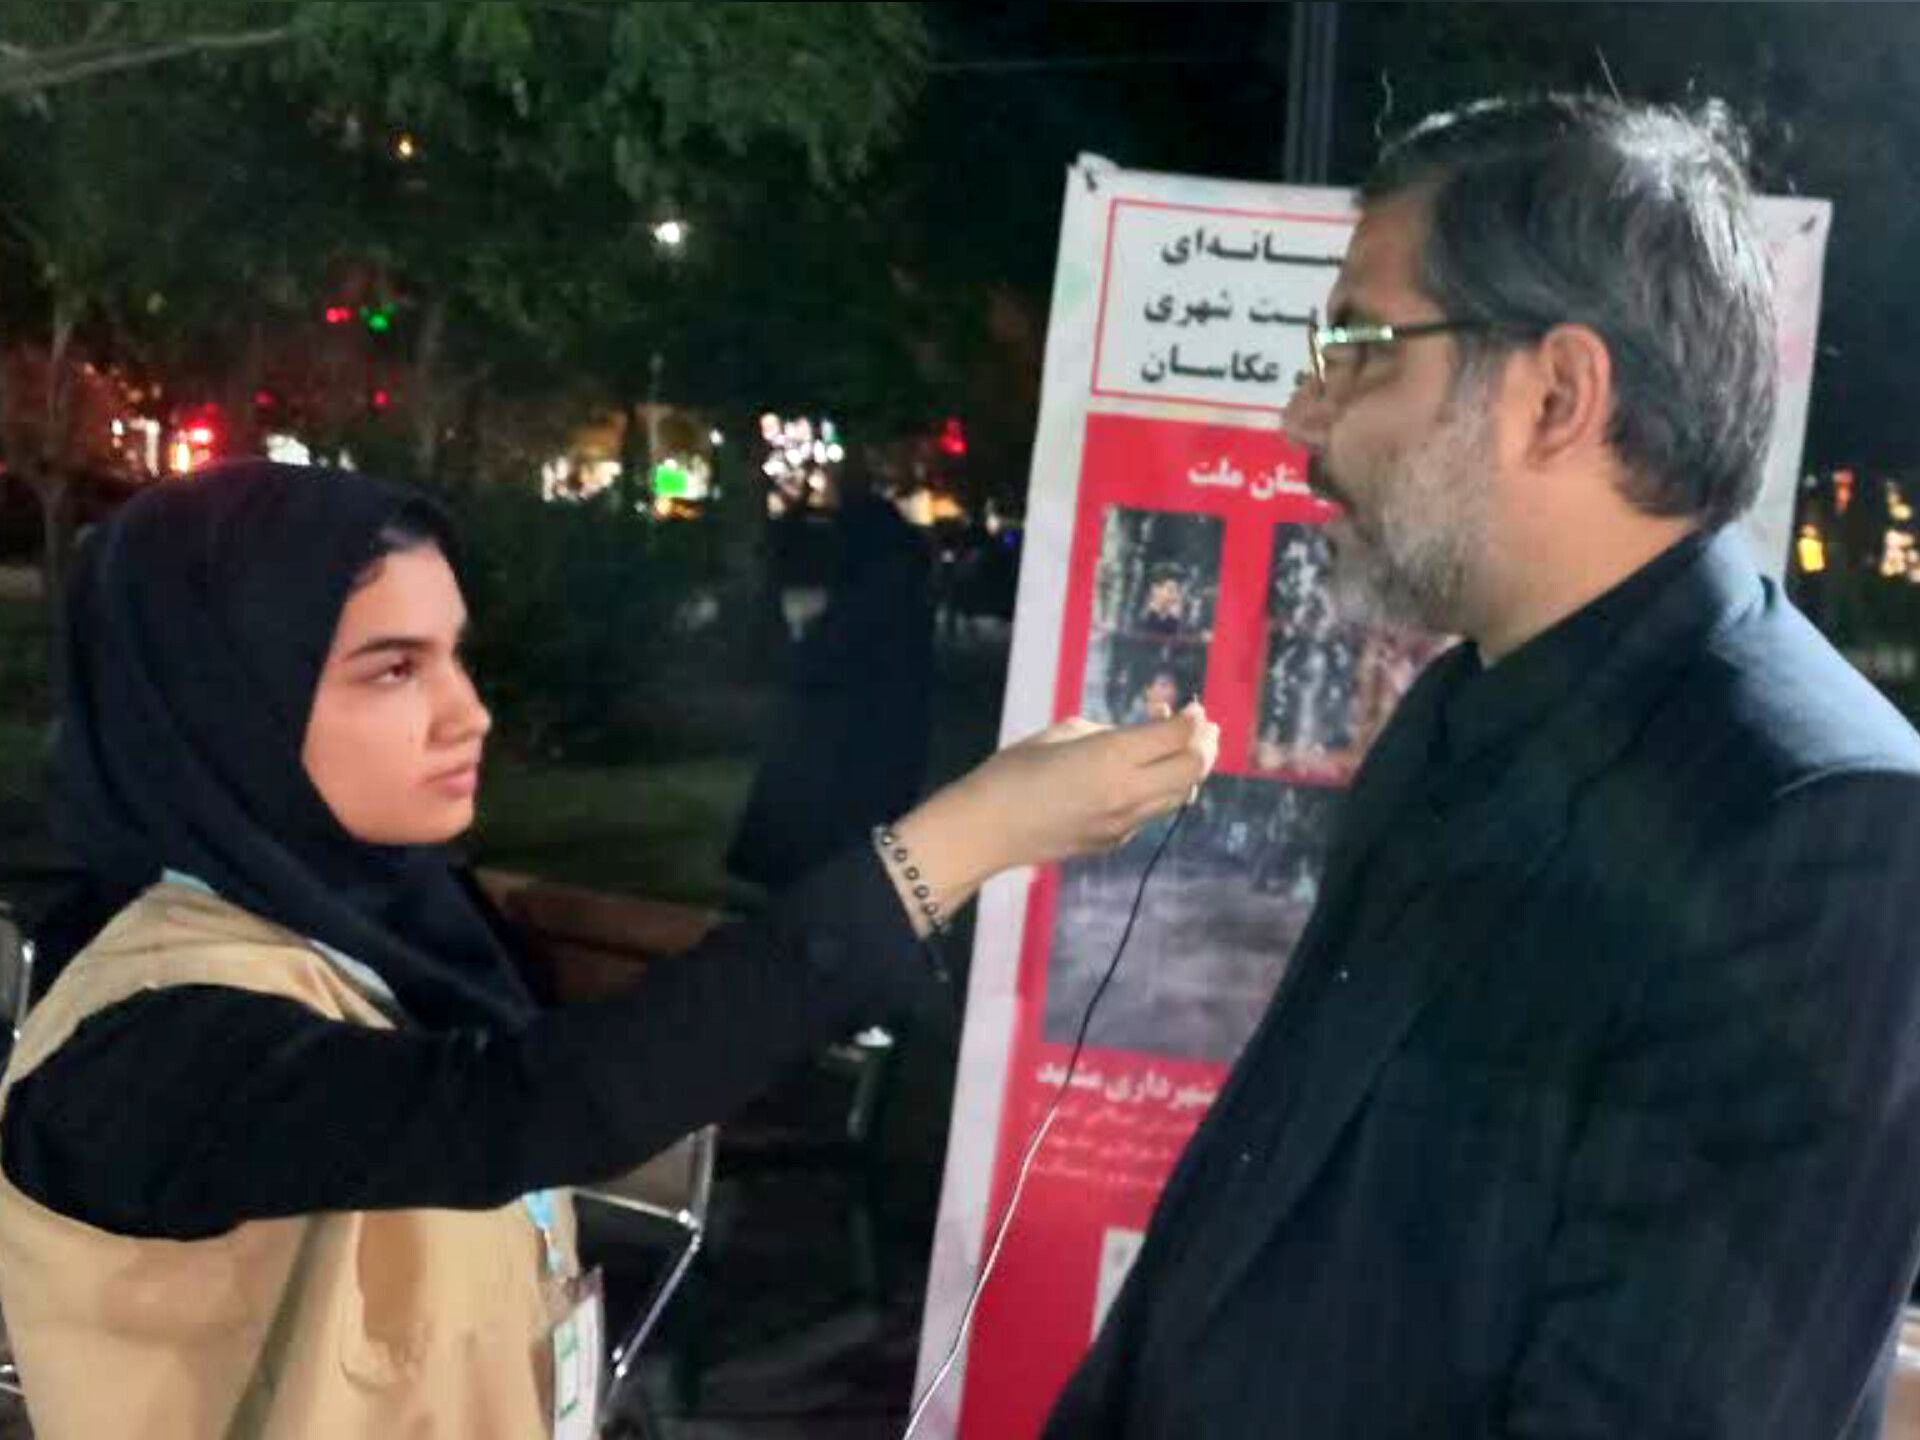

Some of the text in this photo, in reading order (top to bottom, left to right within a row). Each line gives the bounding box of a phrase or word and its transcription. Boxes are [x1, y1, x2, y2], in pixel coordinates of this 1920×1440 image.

[1144, 290, 1233, 326] شهری
[1141, 344, 1279, 384] عکاسان
[1187, 456, 1244, 488] ملت
